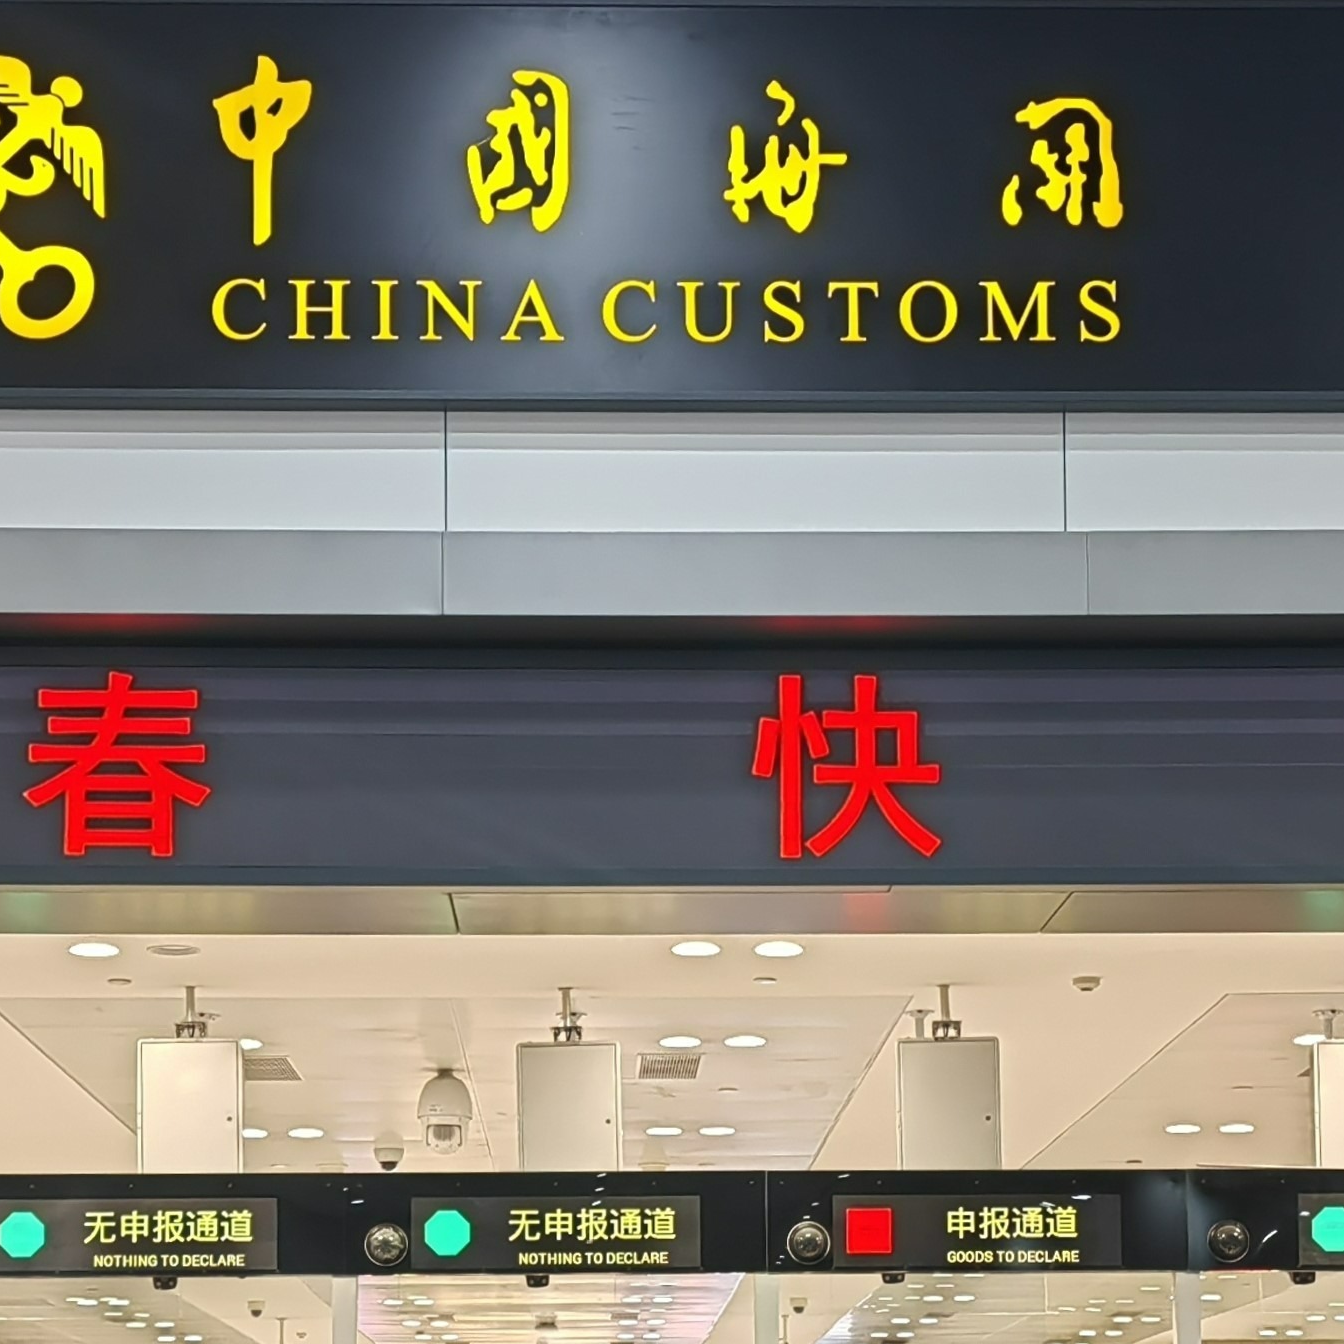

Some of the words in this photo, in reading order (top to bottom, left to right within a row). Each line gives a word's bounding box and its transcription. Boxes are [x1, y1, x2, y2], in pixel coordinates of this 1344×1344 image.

[211, 278, 564, 345] CHINA
[601, 278, 1122, 345] CUSTOMS
[85, 1210, 253, 1244] 无申报通道
[510, 1207, 676, 1242] 无申报通道
[945, 1206, 1079, 1239] 申报通道
[93, 1255, 158, 1268] NOTHING
[162, 1255, 179, 1268] TO
[181, 1255, 245, 1268] DECLARE
[518, 1253, 583, 1266] NOTHING
[586, 1253, 604, 1266] TO
[606, 1253, 669, 1266] DECLARE
[947, 1251, 994, 1264] GOODS
[996, 1251, 1014, 1263] TO
[1017, 1250, 1080, 1263] DECLARE
